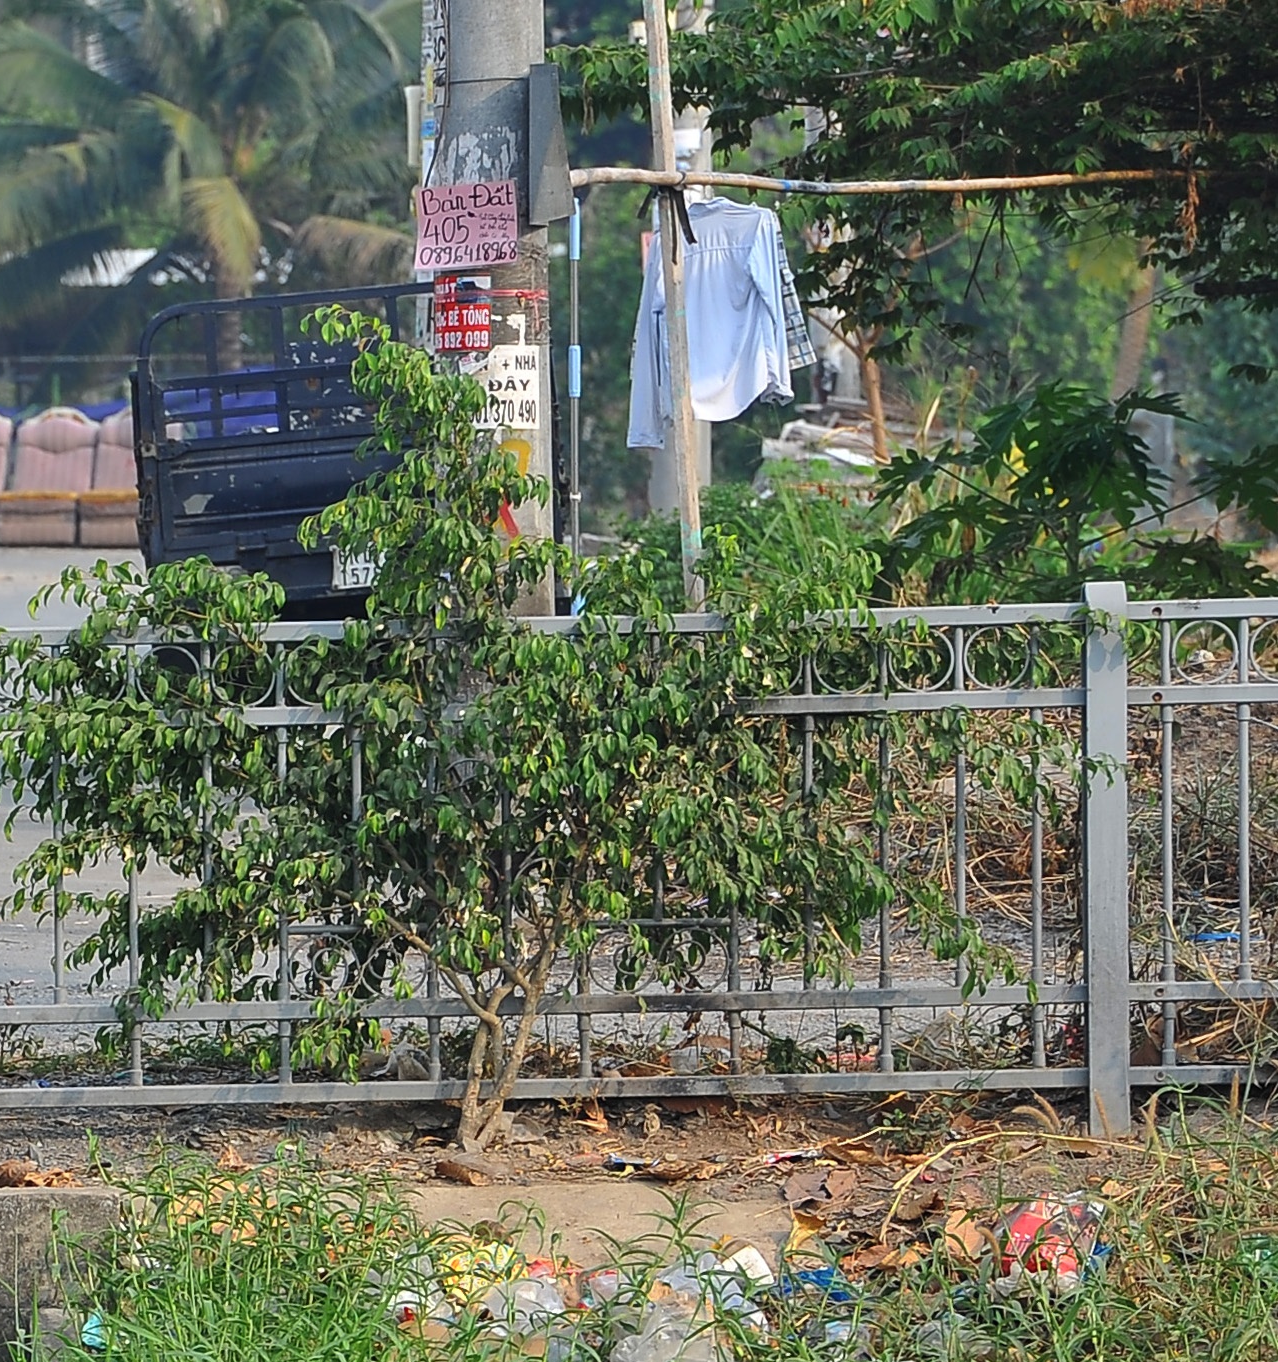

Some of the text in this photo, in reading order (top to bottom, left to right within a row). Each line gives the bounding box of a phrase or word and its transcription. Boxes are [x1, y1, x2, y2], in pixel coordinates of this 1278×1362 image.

[421, 183, 514, 216] Bán Đất
[461, 305, 490, 326] TÔNG
[444, 332, 463, 349] 892
[465, 330, 489, 348] 099
[515, 351, 537, 371] NHÀ
[488, 376, 530, 392] ĐÂY
[518, 400, 537, 424] 490
